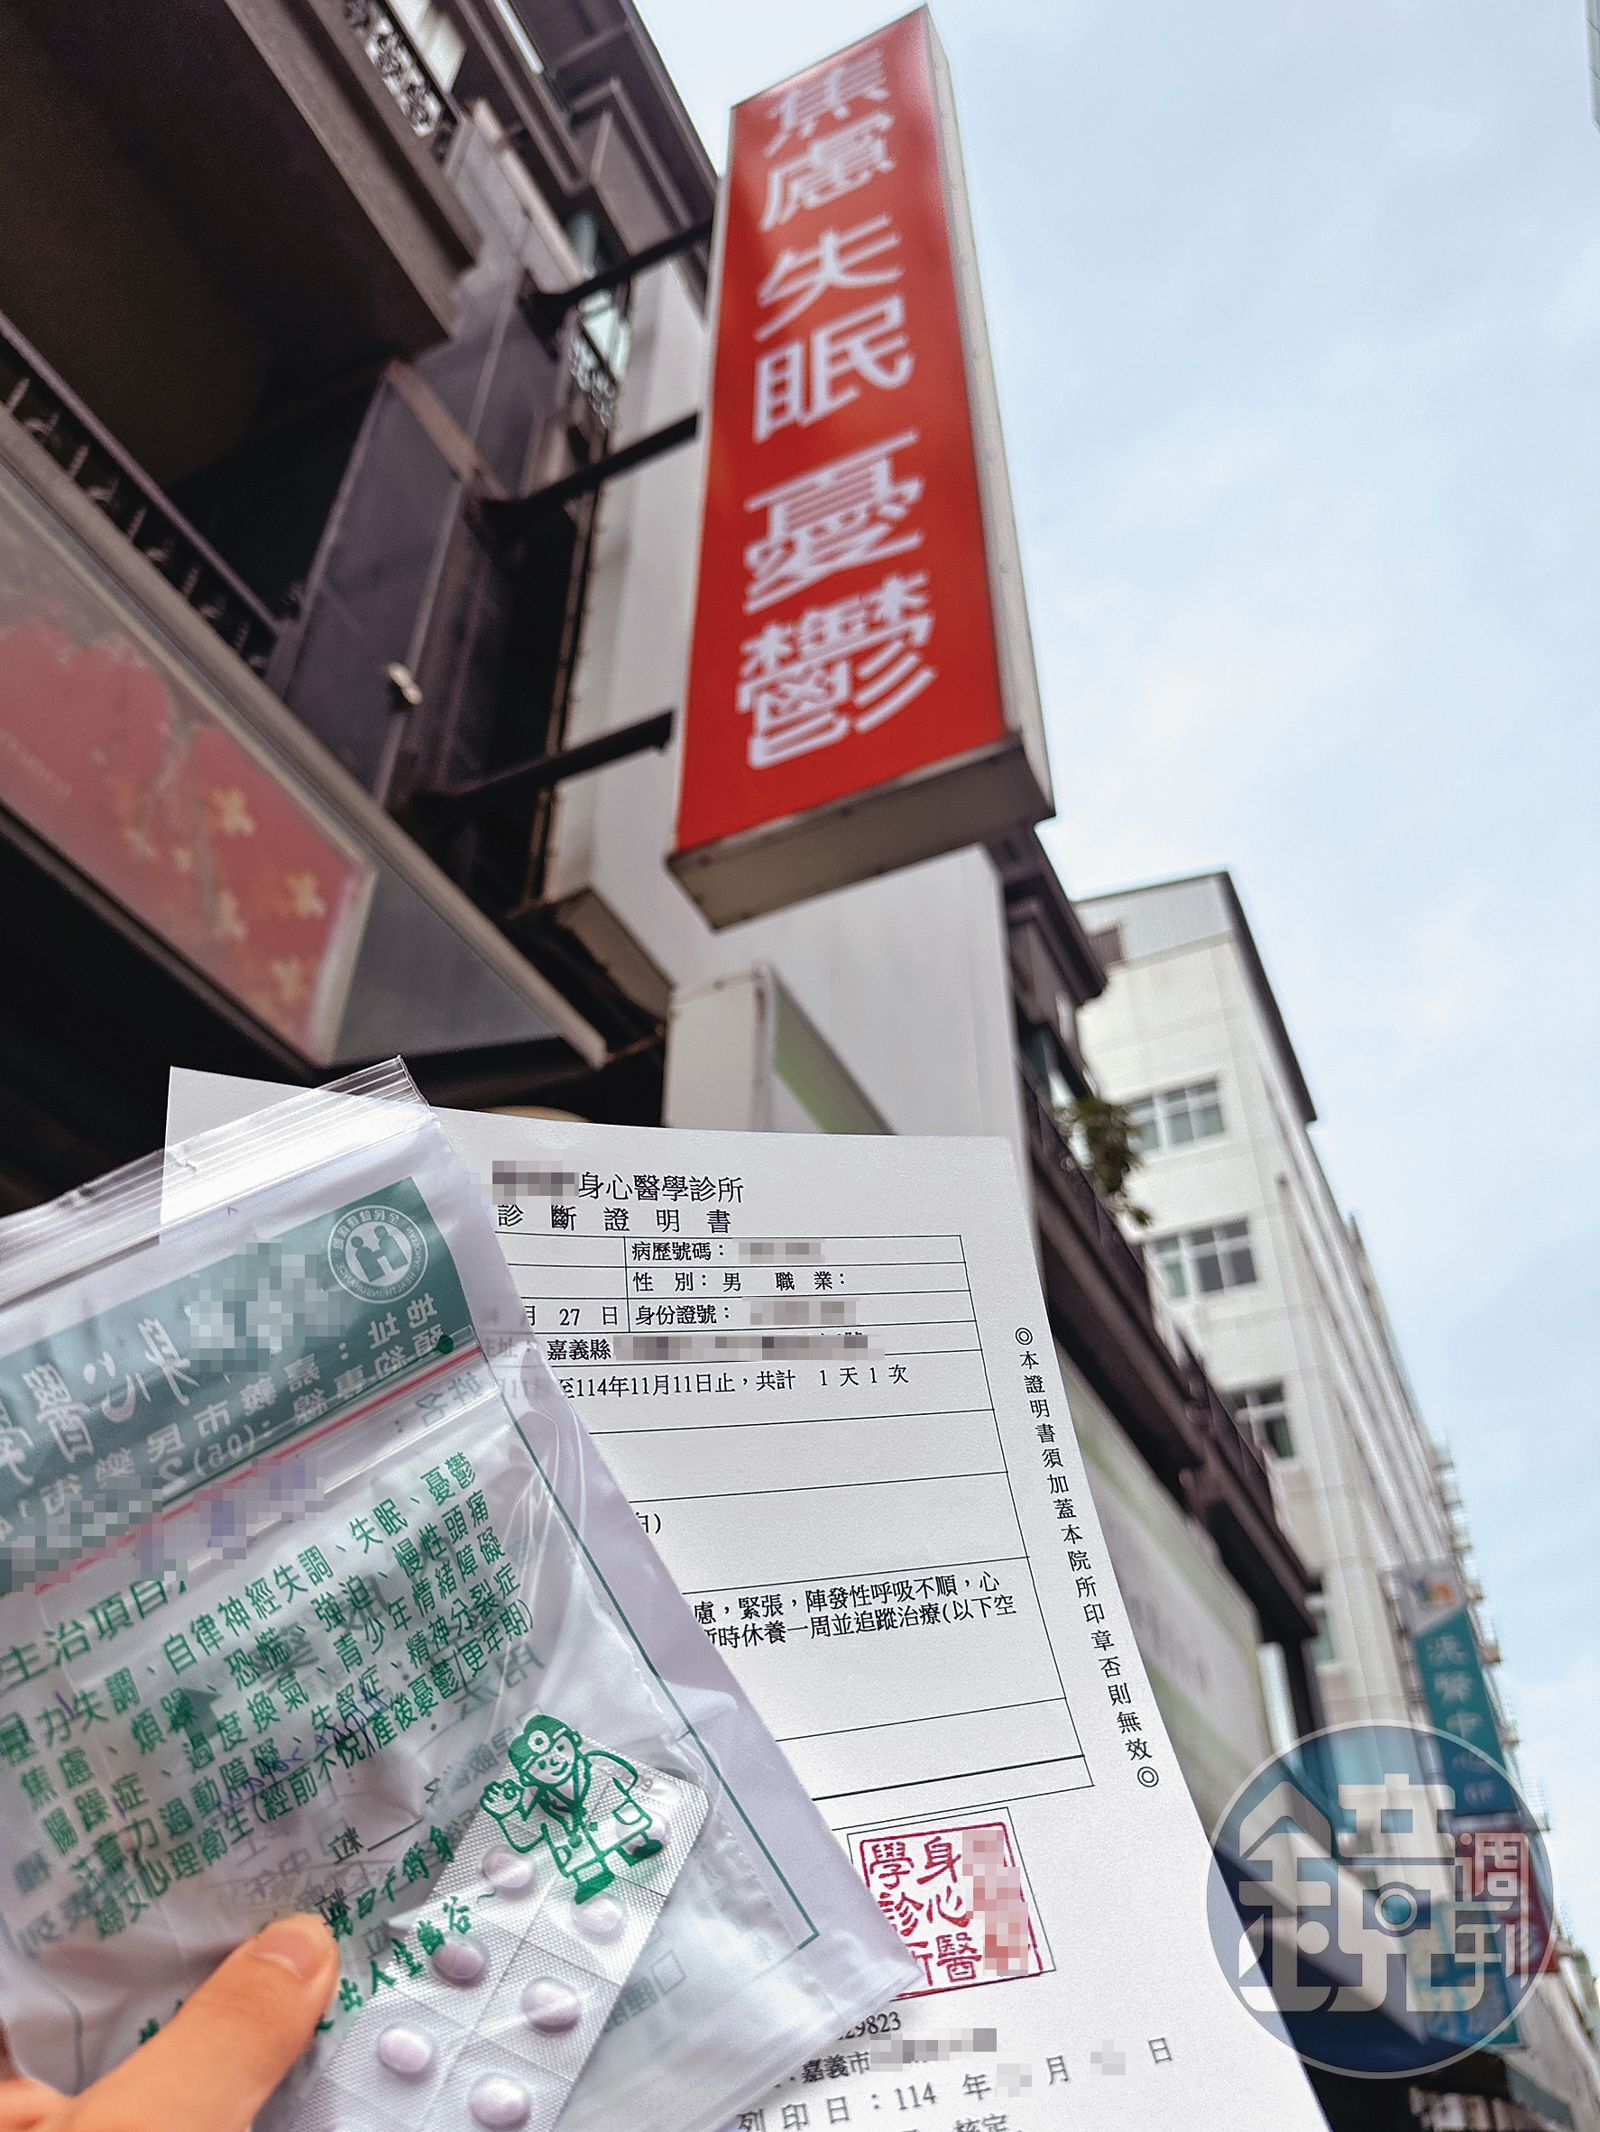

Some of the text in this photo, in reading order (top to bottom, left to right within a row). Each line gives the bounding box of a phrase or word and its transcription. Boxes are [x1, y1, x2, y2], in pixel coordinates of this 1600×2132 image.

[578, 1171, 744, 1204] 身心醫學診所
[559, 1308, 580, 1326] 27
[602, 1306, 618, 1326] 日
[546, 1338, 612, 1361] 嘉義縣
[896, 2081, 937, 2110] 114
